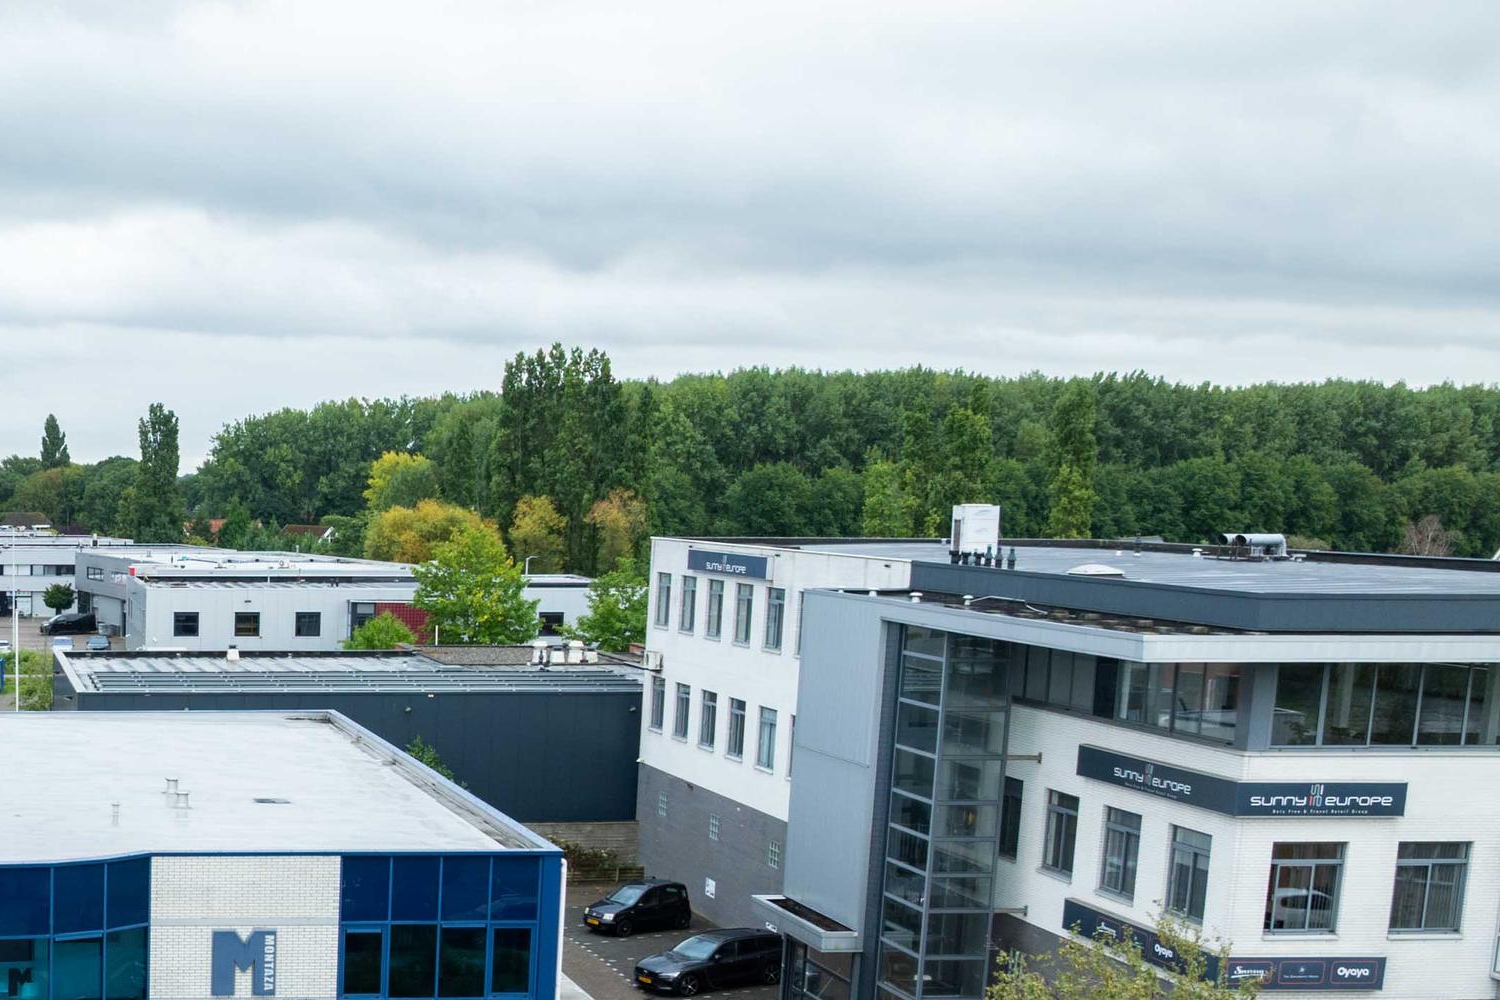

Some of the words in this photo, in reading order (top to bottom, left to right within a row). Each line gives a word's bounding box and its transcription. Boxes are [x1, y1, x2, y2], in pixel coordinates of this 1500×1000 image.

[1113, 767, 1144, 783] sunny
[1152, 777, 1192, 795] europe
[1250, 795, 1307, 807] sunny
[1325, 795, 1393, 806] europe
[263, 935, 275, 991] MONTAZA
[1337, 966, 1370, 979] Oyaya
